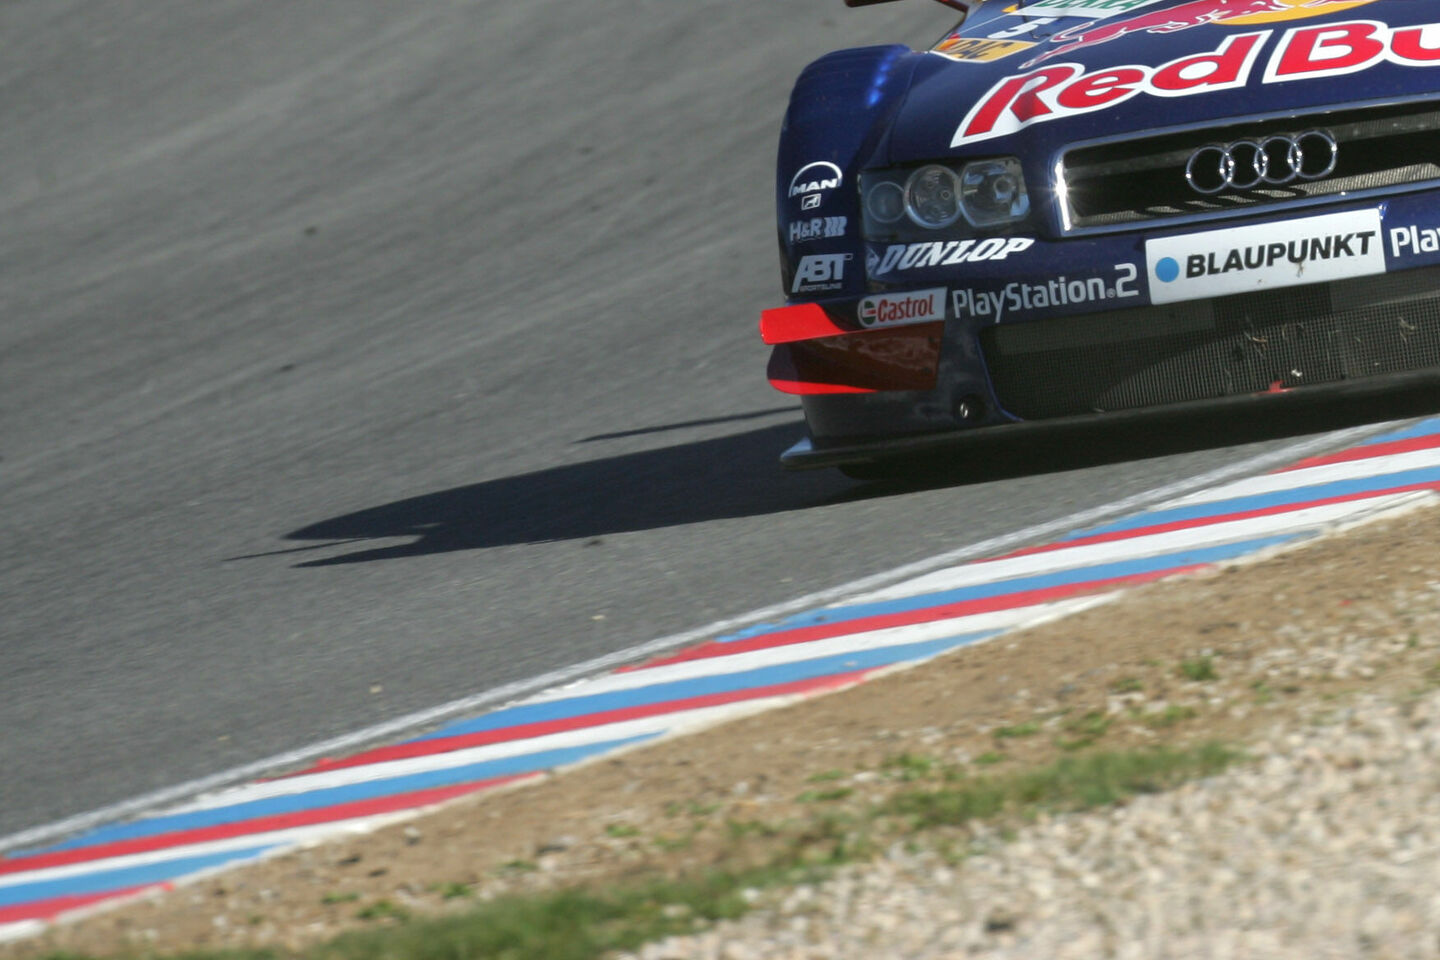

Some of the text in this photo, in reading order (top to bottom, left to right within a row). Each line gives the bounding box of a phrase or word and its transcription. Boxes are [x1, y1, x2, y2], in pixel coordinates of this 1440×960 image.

[953, 30, 1272, 146] Red
[792, 178, 838, 195] MAN
[792, 253, 844, 293] ABT
[876, 237, 1035, 275] DUNLOP
[1186, 230, 1375, 279] BLAUPUNKT
[877, 293, 934, 322] Castrol
[953, 276, 1104, 322] PlayStation
